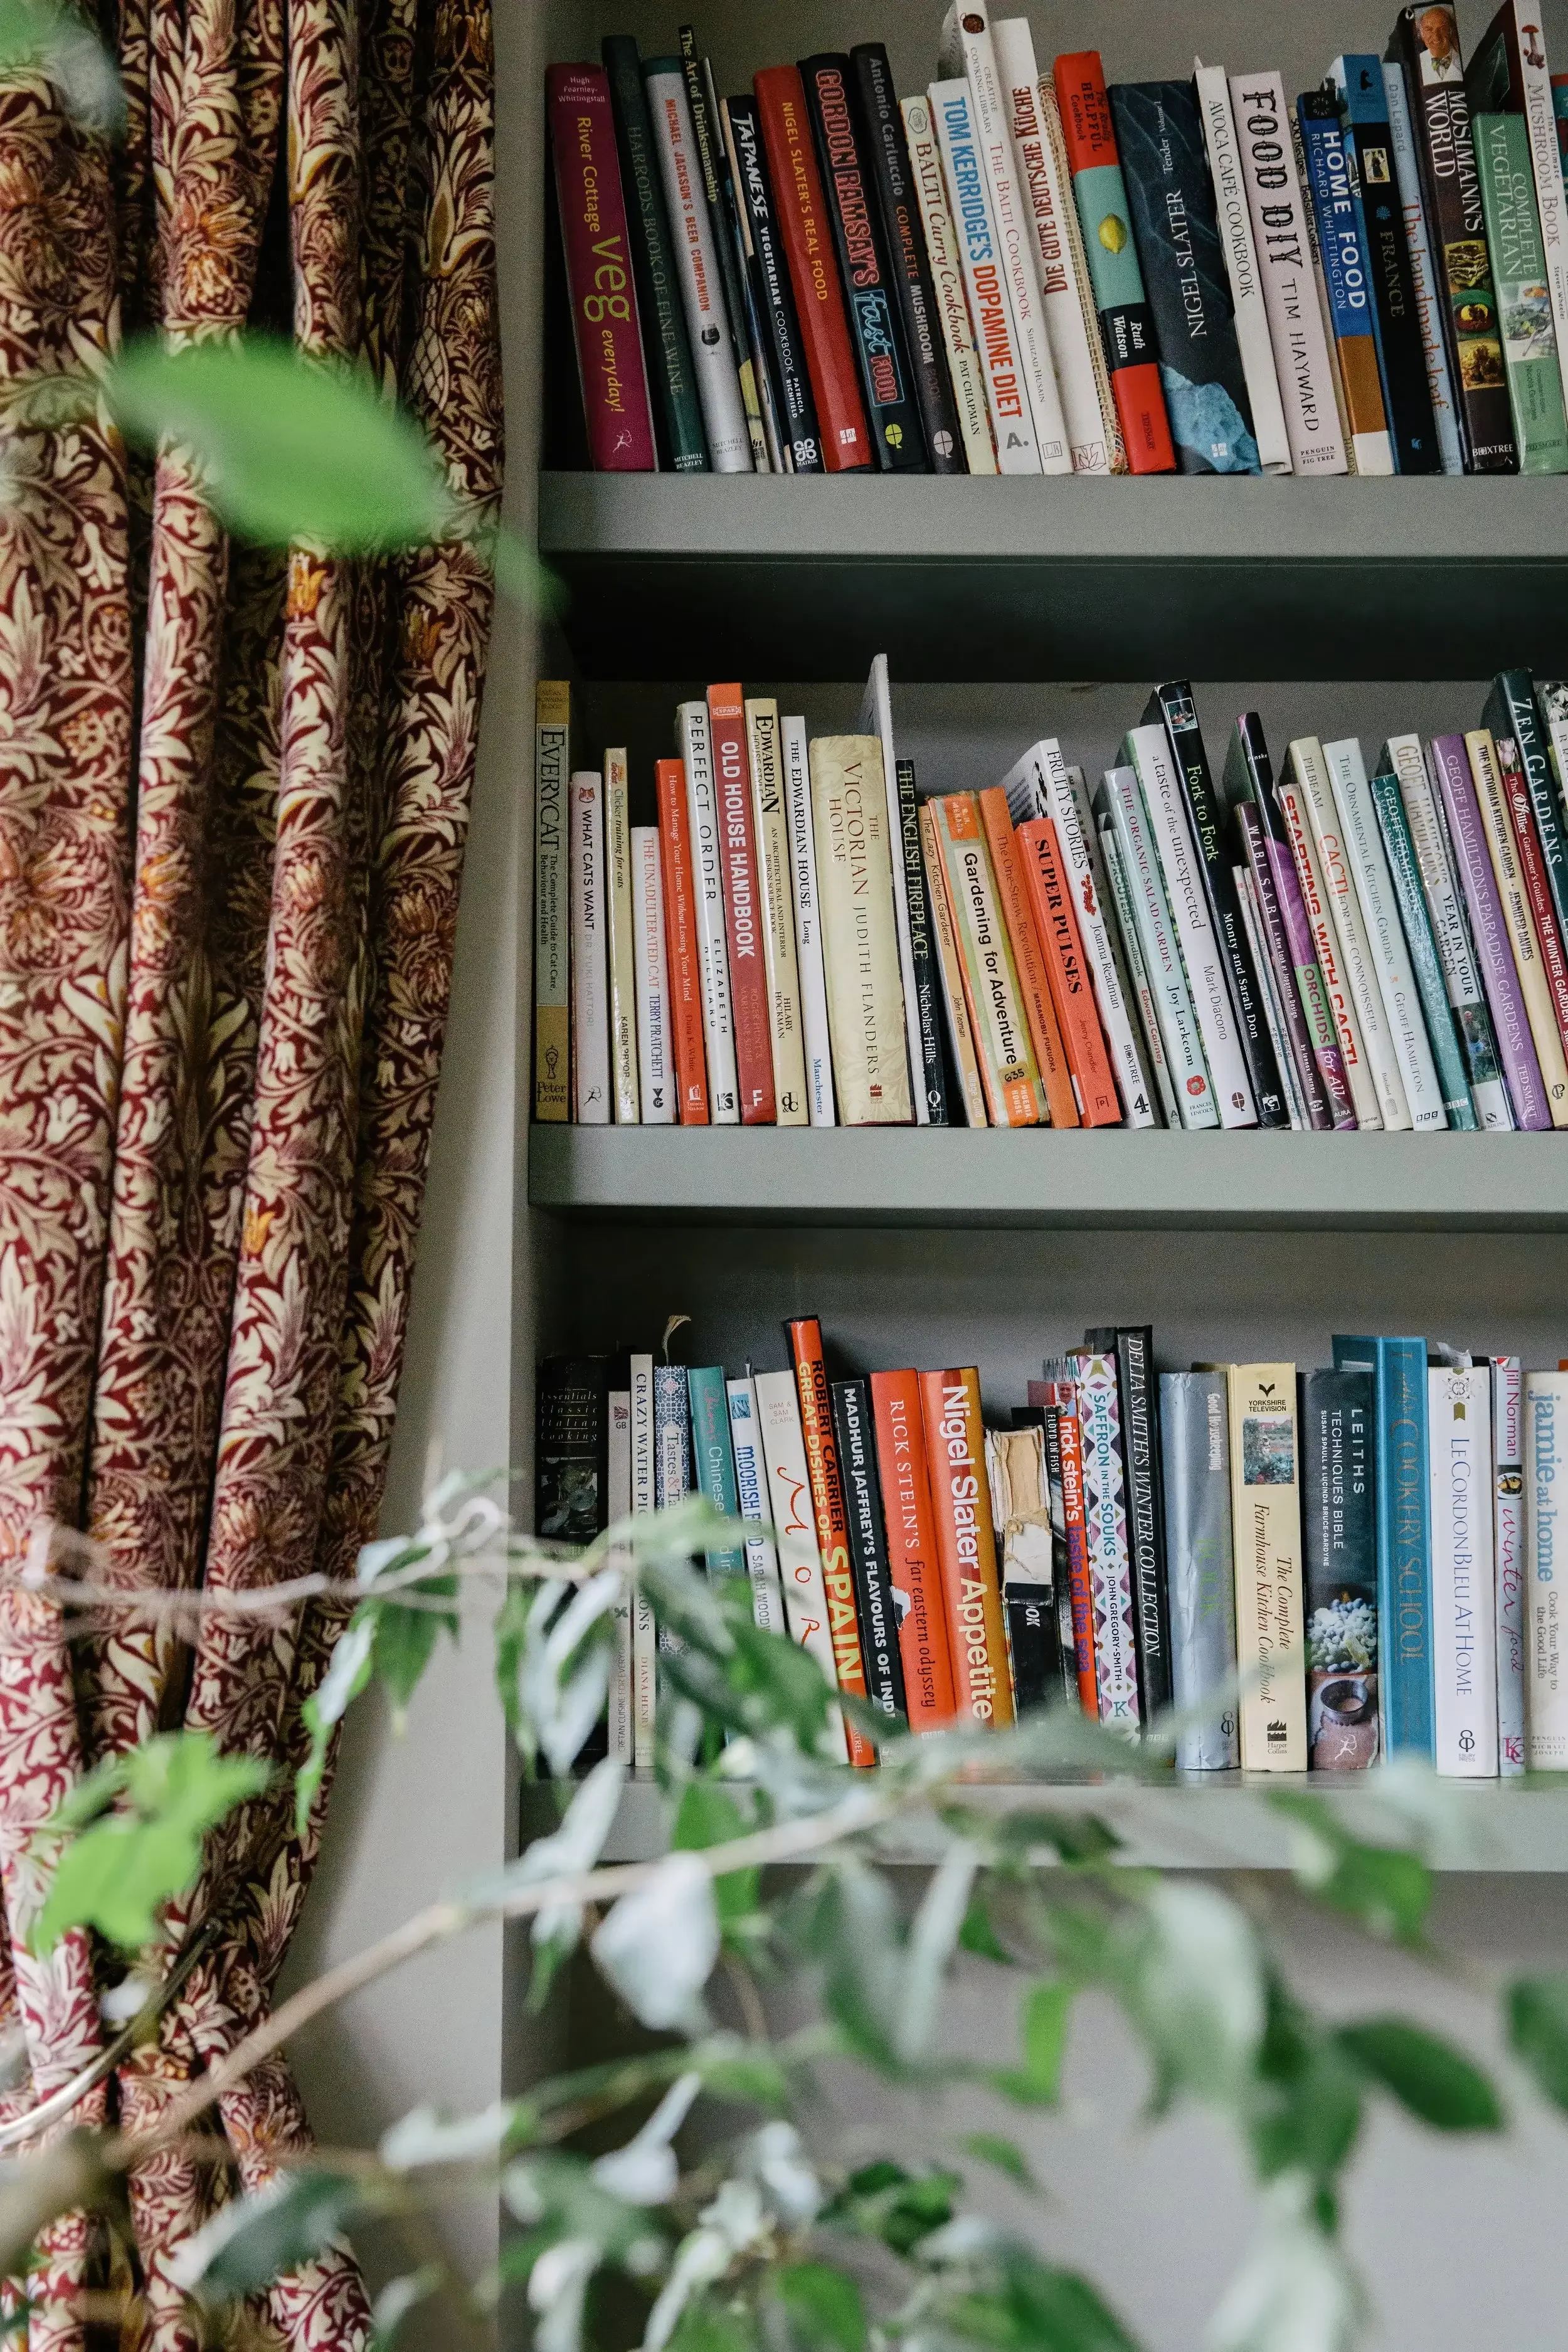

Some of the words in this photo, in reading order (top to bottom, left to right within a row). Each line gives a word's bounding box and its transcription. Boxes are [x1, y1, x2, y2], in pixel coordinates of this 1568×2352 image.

[570, 76, 590, 85] Hugh
[578, 117, 593, 161] River
[816, 70, 858, 167] GORDON
[870, 58, 891, 119] Antonio
[882, 124, 904, 196] Carluccio
[943, 97, 972, 140] TOM
[1209, 101, 1228, 150] AVOCA
[1243, 90, 1288, 189] FOOD
[1426, 93, 1455, 177] WORLD
[916, 143, 940, 208] BALTI
[1218, 154, 1237, 196] CAFÉ
[1449, 90, 1483, 231] MOSIMANN'S
[582, 166, 601, 232] Cottage
[782, 102, 798, 144] NIGEL
[791, 149, 812, 214] SLATER'S
[803, 219, 818, 255] REAL
[812, 260, 827, 300] FOOD
[834, 170, 879, 287] RAMSAY'S
[951, 145, 993, 261] KERRIDGE'S
[1313, 134, 1329, 199] RICHARD
[1323, 204, 1346, 309] WHITTINGTON
[1323, 132, 1350, 214] HOME
[1339, 231, 1365, 308] FOOD
[731, 112, 769, 218] JAPANESE
[760, 226, 782, 305] VEGETARIAN
[776, 310, 795, 372] COOKBOOK
[929, 213, 948, 265] Curry
[1226, 201, 1254, 298] COOKBOOK
[1260, 203, 1303, 268] DIY
[584, 235, 630, 322] Veg
[896, 206, 918, 278] COMPLETE
[909, 285, 934, 364] MUSHROOM
[1282, 278, 1300, 319] TIM
[854, 293, 892, 354] fast
[941, 270, 969, 353] Cookbook
[973, 265, 1013, 370] DOPAMINE
[1113, 315, 1128, 358] Watson
[1130, 321, 1145, 349] Ruth
[601, 330, 625, 411] everyday!
[870, 355, 898, 402] FOOD
[959, 360, 970, 378] PAT
[993, 374, 1022, 417] DIET
[1289, 332, 1318, 430] HAYWARD
[963, 381, 979, 435] CHAPMAN
[690, 716, 710, 811] PERFECT
[721, 742, 741, 778] OLD
[755, 714, 780, 815] EDWARDIAN
[791, 740, 800, 763] THE
[898, 766, 913, 797] THE
[1155, 763, 1171, 800] taste
[1187, 765, 1203, 802] Fork
[1512, 697, 1536, 744] ZEN
[1526, 754, 1562, 866] GARDENS
[541, 729, 566, 852] EVERYCAT
[724, 785, 745, 848] HOUSE
[792, 768, 807, 854] EDWARDIAN
[1163, 803, 1173, 814] of
[1198, 805, 1207, 820] to
[583, 810, 592, 849] WHAT
[829, 798, 846, 863] HOUSE
[844, 762, 869, 896] VICTORIAN
[869, 815, 880, 840] THE
[901, 801, 920, 871] ENGLISH
[1167, 817, 1177, 834] the
[1200, 824, 1219, 862] Fork
[583, 852, 593, 886] CATS
[699, 825, 716, 901] ORDER
[798, 859, 811, 909] HOUSE
[1047, 750, 1071, 804] FRUITY
[1061, 805, 1088, 869] STORIES
[1091, 924, 1106, 960] Joanna
[1102, 963, 1120, 1009] Readman
[1172, 837, 1205, 930] unexpected
[583, 891, 594, 930] WANT
[729, 854, 755, 958] HANDBOOK
[906, 874, 928, 960] FIREPLACE
[964, 853, 991, 945] Gardening
[1035, 839, 1062, 912] SUPER
[1052, 916, 1083, 994] PULSES
[853, 906, 871, 973] JUDITH
[985, 951, 999, 975] for
[649, 994, 661, 1022] TERRY
[919, 983, 933, 1034] Nicholas
[1203, 966, 1216, 993] Mark
[1210, 997, 1227, 1040] Diacono
[1224, 913, 1238, 950] Monty
[1232, 953, 1246, 975] and
[1239, 978, 1250, 1011] Sarah
[1247, 1014, 1258, 1039] Don
[1303, 968, 1331, 1044] ORCHIDS
[650, 1024, 664, 1079] PRATCHETT
[861, 983, 879, 1074] FLANDERS
[924, 1035, 937, 1064] Hills
[990, 978, 1017, 1064] Adventure
[1167, 985, 1179, 1006] Joy
[1175, 1010, 1194, 1067] Larkcom
[813, 1059, 823, 1115] Manchester
[1320, 1049, 1336, 1072] for
[1329, 1076, 1345, 1099] All
[1334, 1110, 1350, 1118] AURA
[800, 1362, 817, 1428] GREAT
[1128, 1337, 1144, 1392] DELIA
[1503, 1367, 1519, 1386] Jill
[637, 1374, 647, 1428] CRAZY
[844, 1389, 864, 1466] MADHUR
[890, 1401, 909, 1455] RICK
[940, 1386, 975, 1466] Nigel
[1094, 1395, 1110, 1467] SAFFRON
[1131, 1395, 1149, 1467] SMITH'S
[1507, 1392, 1517, 1456] Norman
[637, 1432, 649, 1486] WATER
[812, 1360, 832, 1438] ROBERT
[823, 1446, 844, 1533] CARRIER
[1332, 1410, 1343, 1504] TECHNIQUES
[1352, 1409, 1364, 1494] LEITHS
[1451, 1439, 1470, 1458] LE
[1528, 1390, 1562, 1483] jamie
[807, 1434, 827, 1507] DISHES
[1101, 1470, 1108, 1480] IN
[1536, 1486, 1554, 1505] at
[818, 1515, 832, 1540] OF
[852, 1469, 875, 1557] JAFFREY'S
[898, 1463, 920, 1549] STEIN'S
[951, 1476, 979, 1569] Slater
[1101, 1503, 1115, 1555] SOUKS
[1135, 1470, 1153, 1544] WINTER
[1333, 1508, 1343, 1549] BIBLE
[1452, 1461, 1471, 1549] CORDON
[906, 1558, 925, 1583] far
[1254, 1503, 1271, 1578] Farmhouse
[1277, 1557, 1291, 1582] The
[1536, 1508, 1558, 1582] home
[866, 1562, 886, 1647] FLAVOURS
[1106, 1576, 1116, 1600] JOHN
[1138, 1547, 1160, 1656] COLLECTION
[1256, 1581, 1272, 1631] Kitchen
[1454, 1554, 1471, 1599] BLEU
[821, 1545, 862, 1680] SPAIN
[909, 1588, 928, 1642] eastern
[1110, 1602, 1121, 1681] GREGORY-SMITH
[1275, 1585, 1293, 1650] Complete
[1455, 1604, 1472, 1631] AT
[877, 1653, 891, 1675] OF
[918, 1647, 935, 1708] odyssey
[956, 1578, 996, 1720] Appetite
[1258, 1636, 1276, 1703] Cookbook
[1456, 1636, 1474, 1696] HOME
